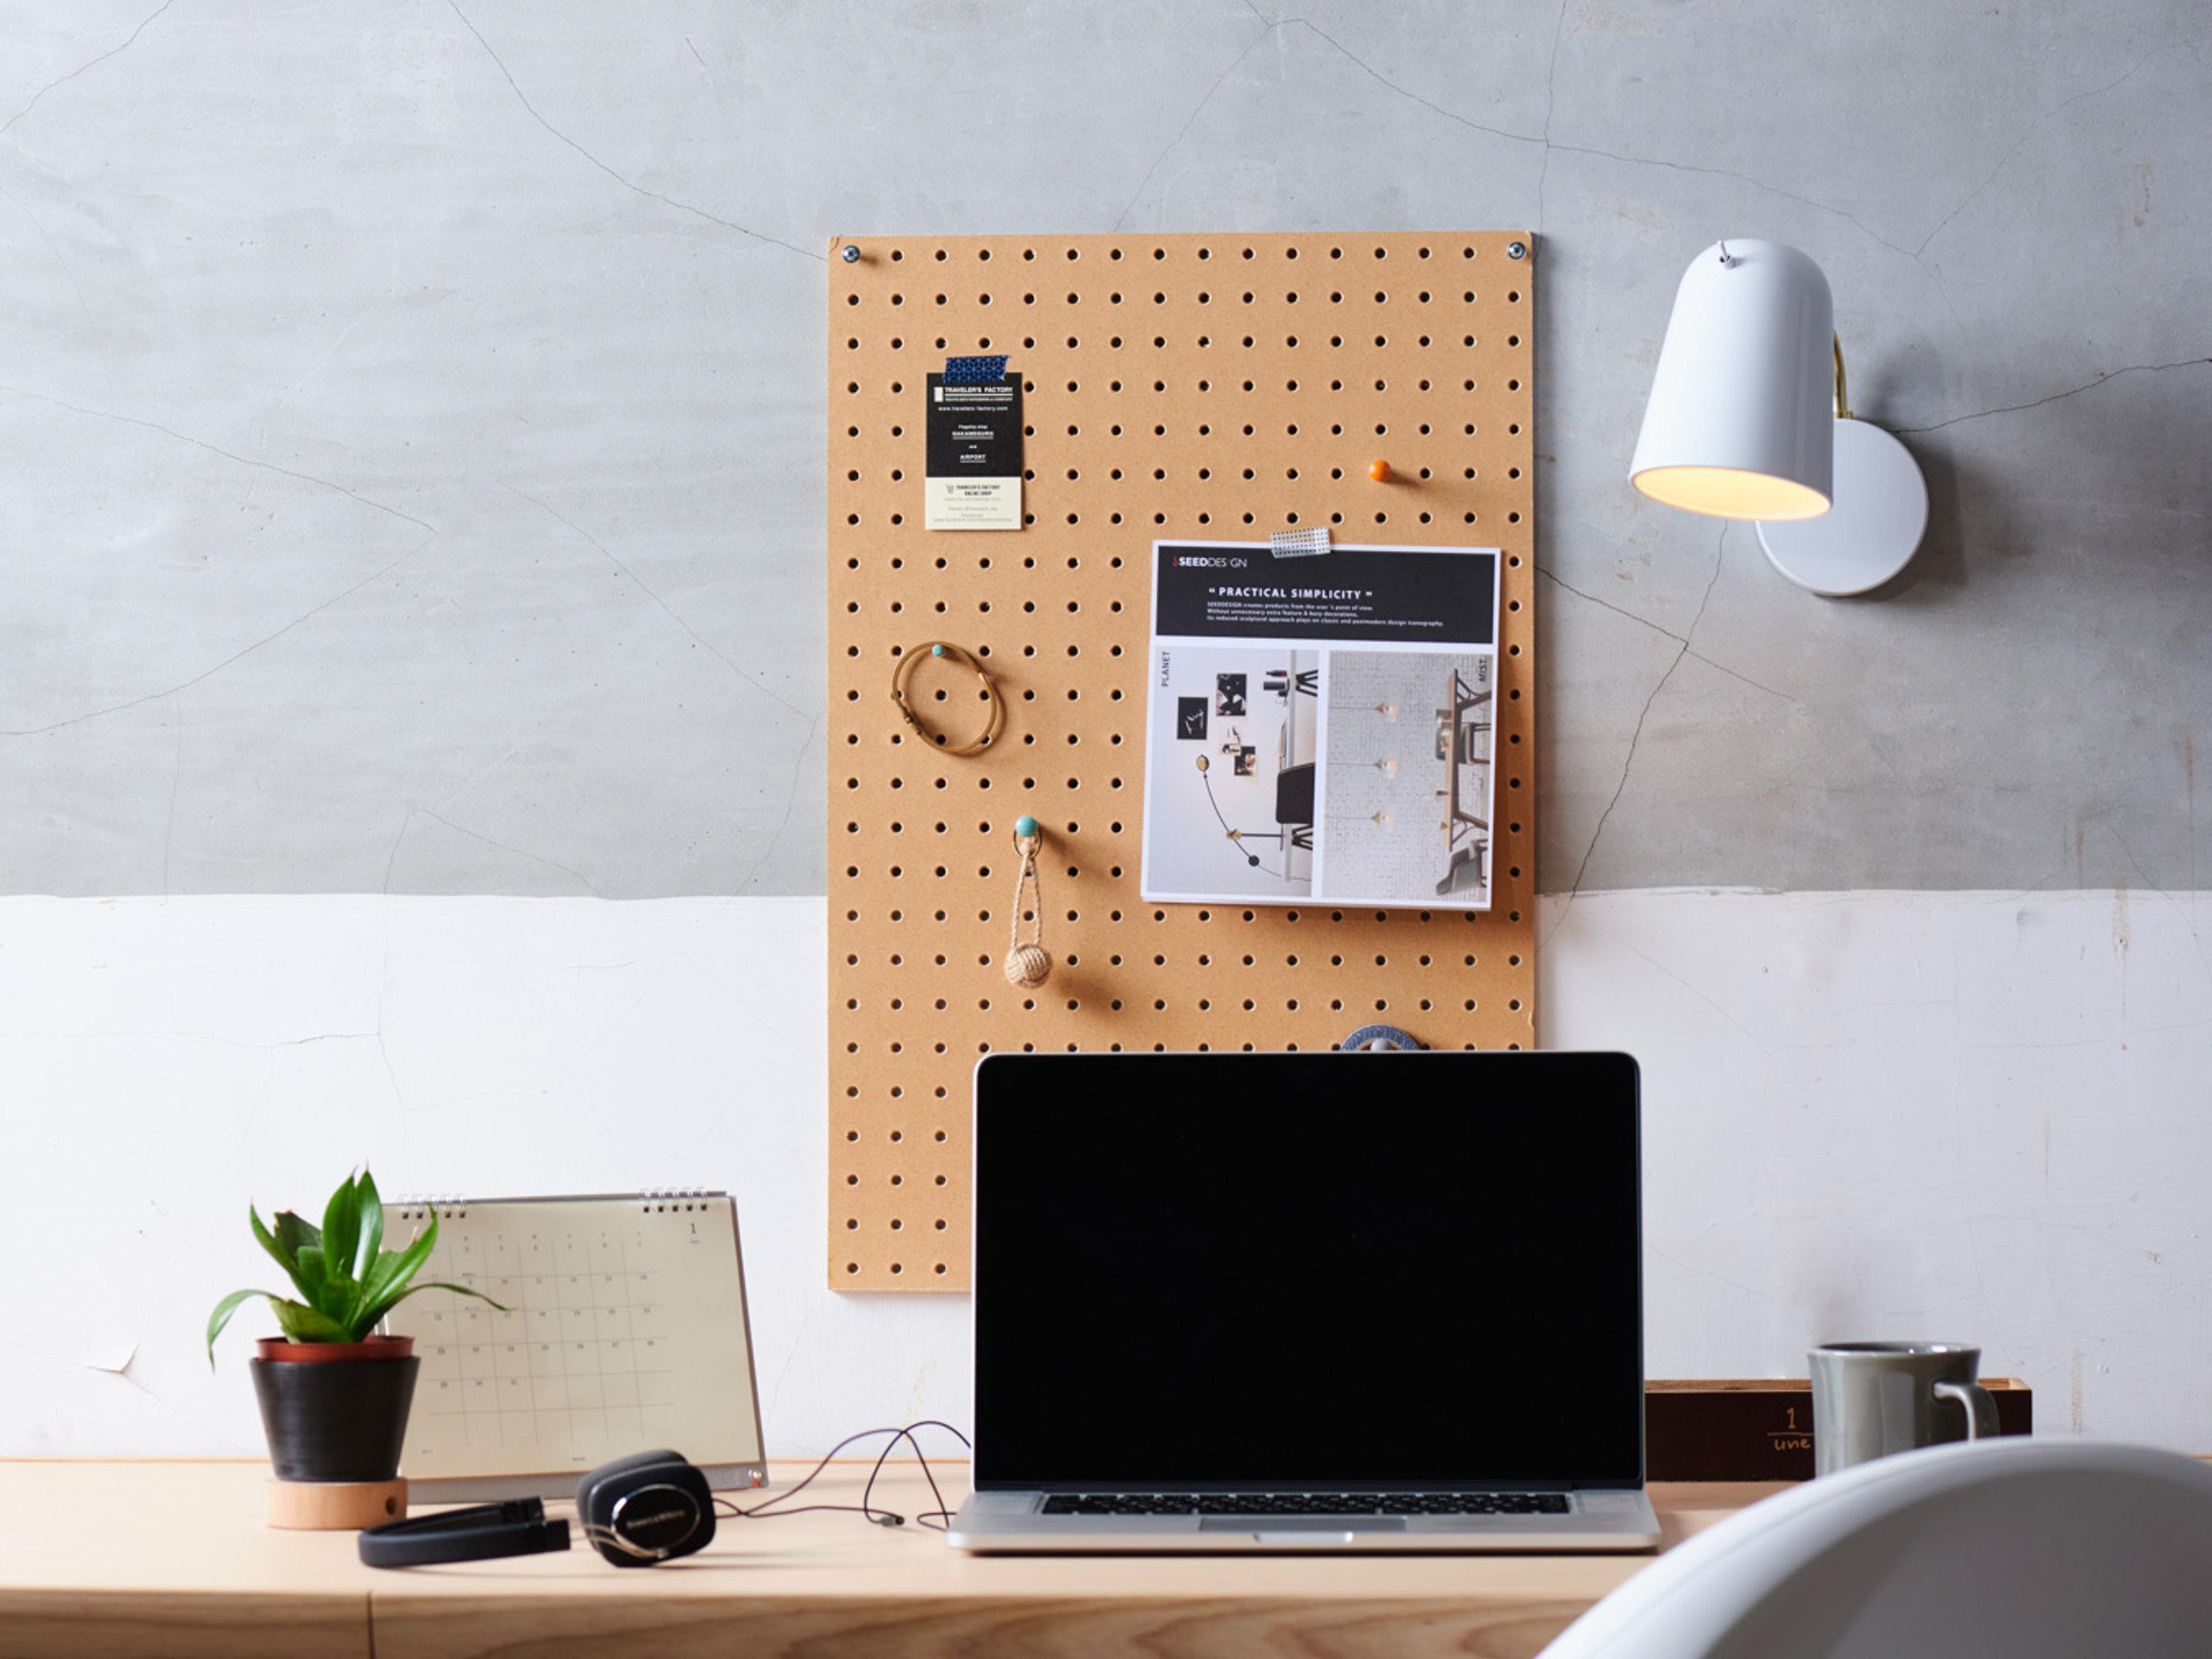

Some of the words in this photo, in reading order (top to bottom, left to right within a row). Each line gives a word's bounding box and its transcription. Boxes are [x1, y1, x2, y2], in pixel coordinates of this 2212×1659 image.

[1218, 586, 1287, 598] PRACTICAL
[1290, 588, 1361, 600] SIMPLICITY
[1161, 651, 1171, 687] PLANET
[1478, 658, 1487, 682] MIST
[690, 1222, 696, 1234] 1
[1787, 1407, 1796, 1429] 1
[1774, 1438, 1811, 1451] une
